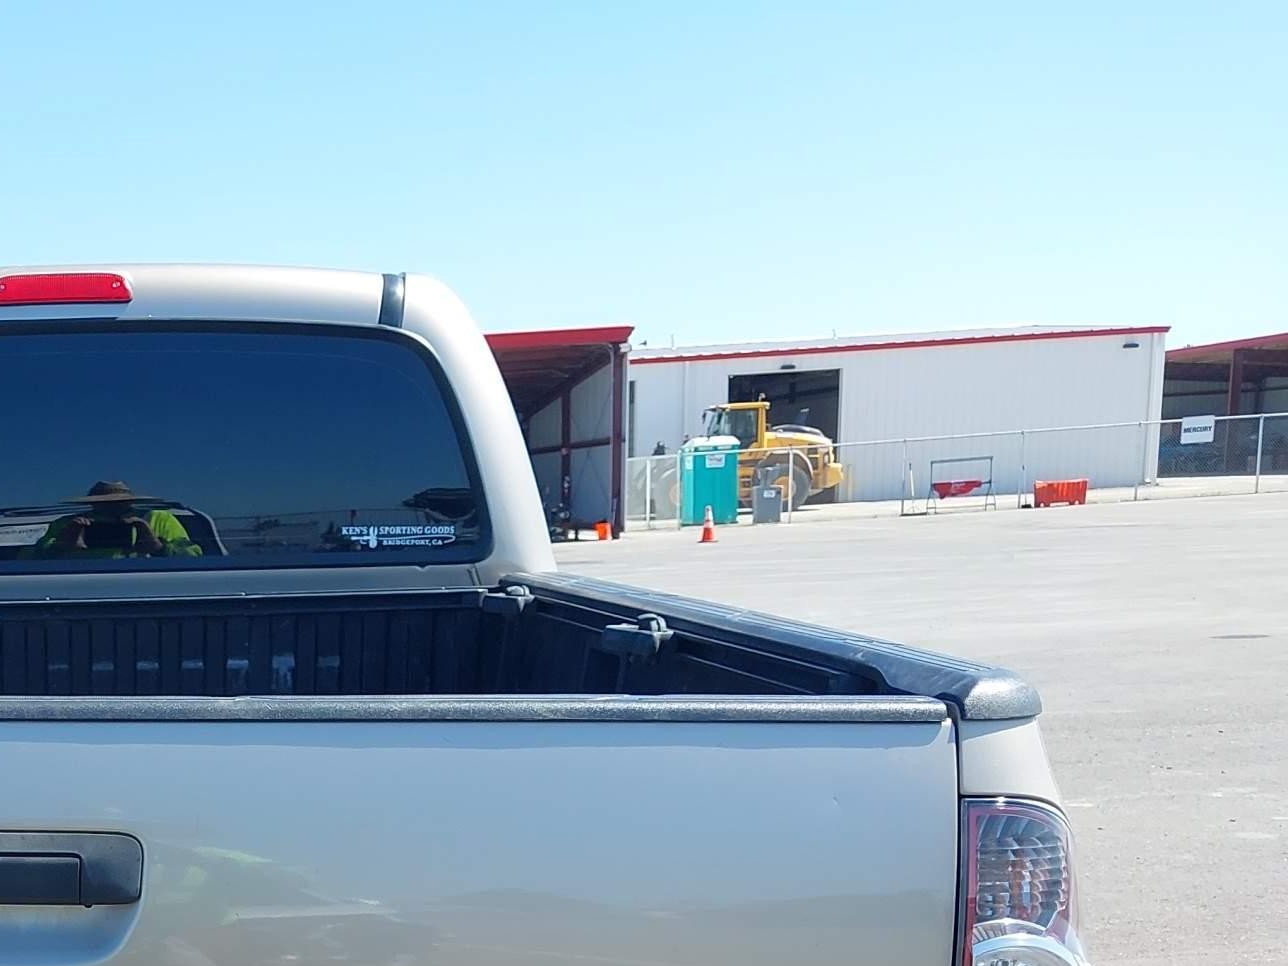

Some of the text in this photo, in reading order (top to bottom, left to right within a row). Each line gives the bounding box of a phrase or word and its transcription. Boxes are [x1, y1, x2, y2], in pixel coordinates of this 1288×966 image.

[1183, 425, 1213, 433] MERCURY
[341, 526, 455, 535] KEN'S SPORTING GOODS
